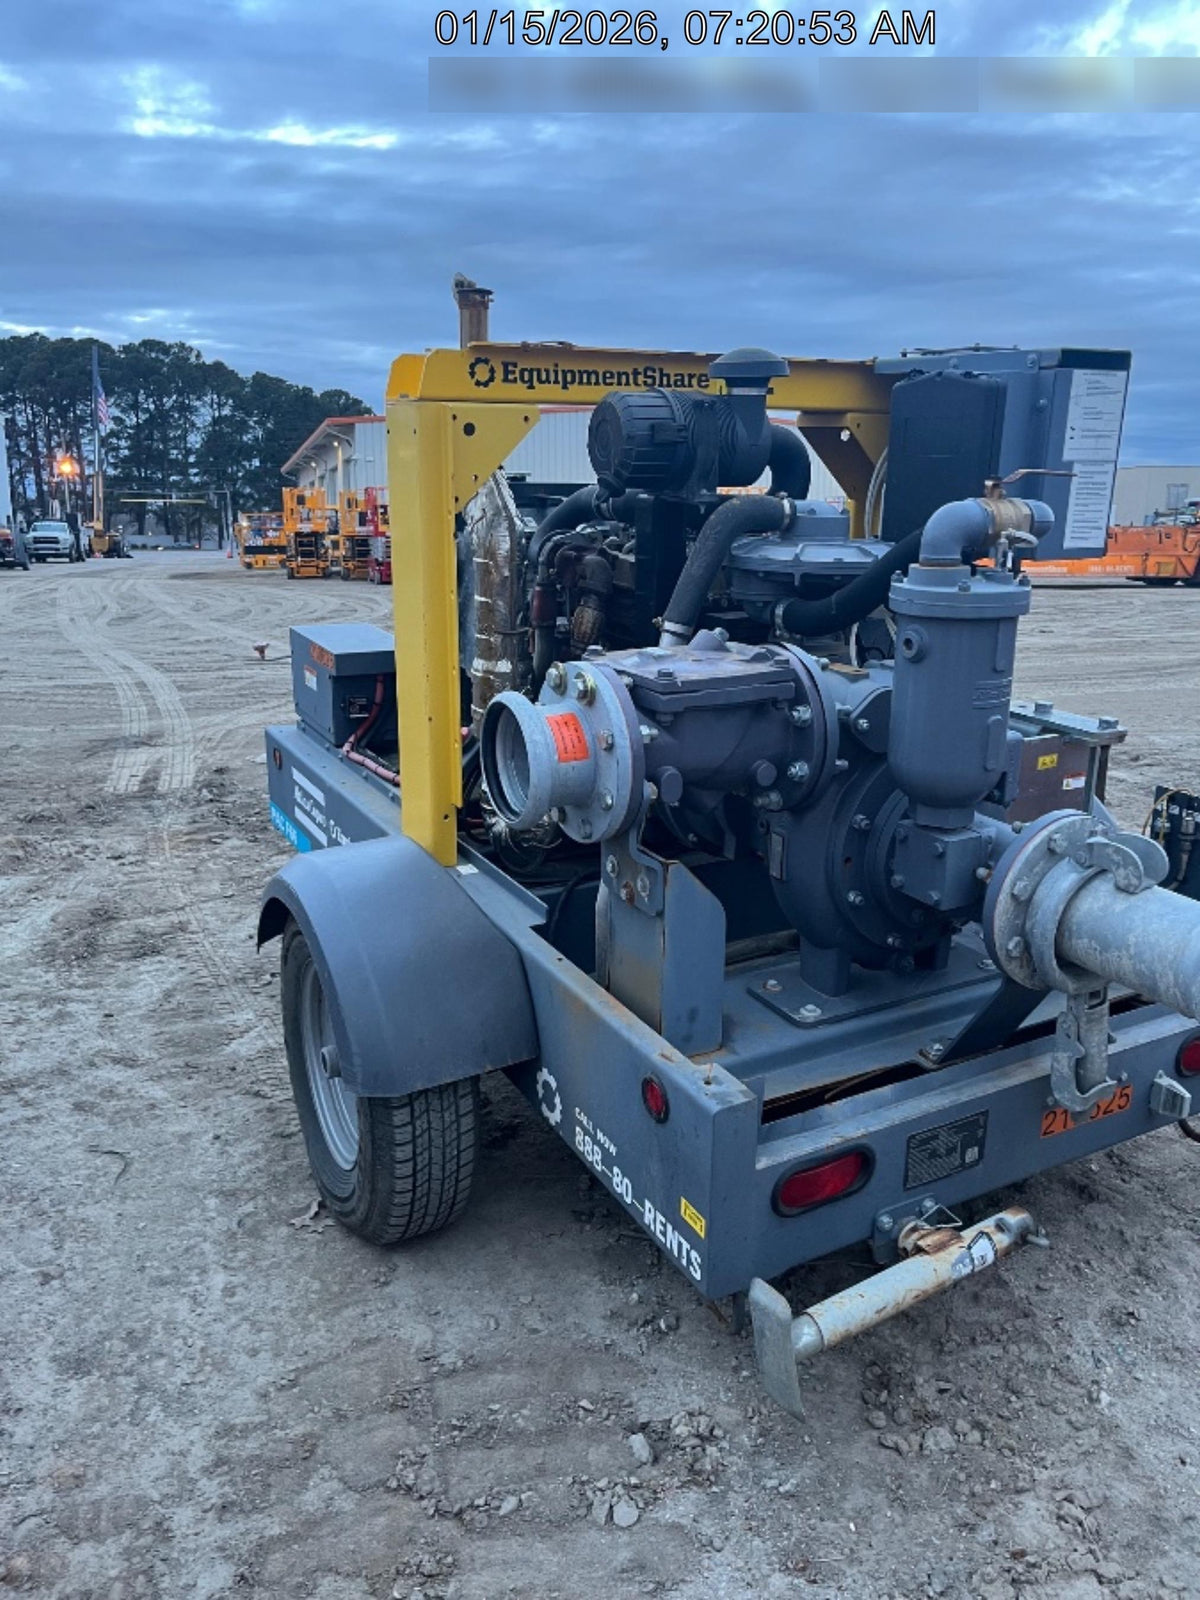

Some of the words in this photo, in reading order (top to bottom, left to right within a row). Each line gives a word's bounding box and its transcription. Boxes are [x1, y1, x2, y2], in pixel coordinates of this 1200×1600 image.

[500, 360, 710, 390] EquipmentShare
[575, 1107, 594, 1135] CALL
[596, 1128, 617, 1157] NOW
